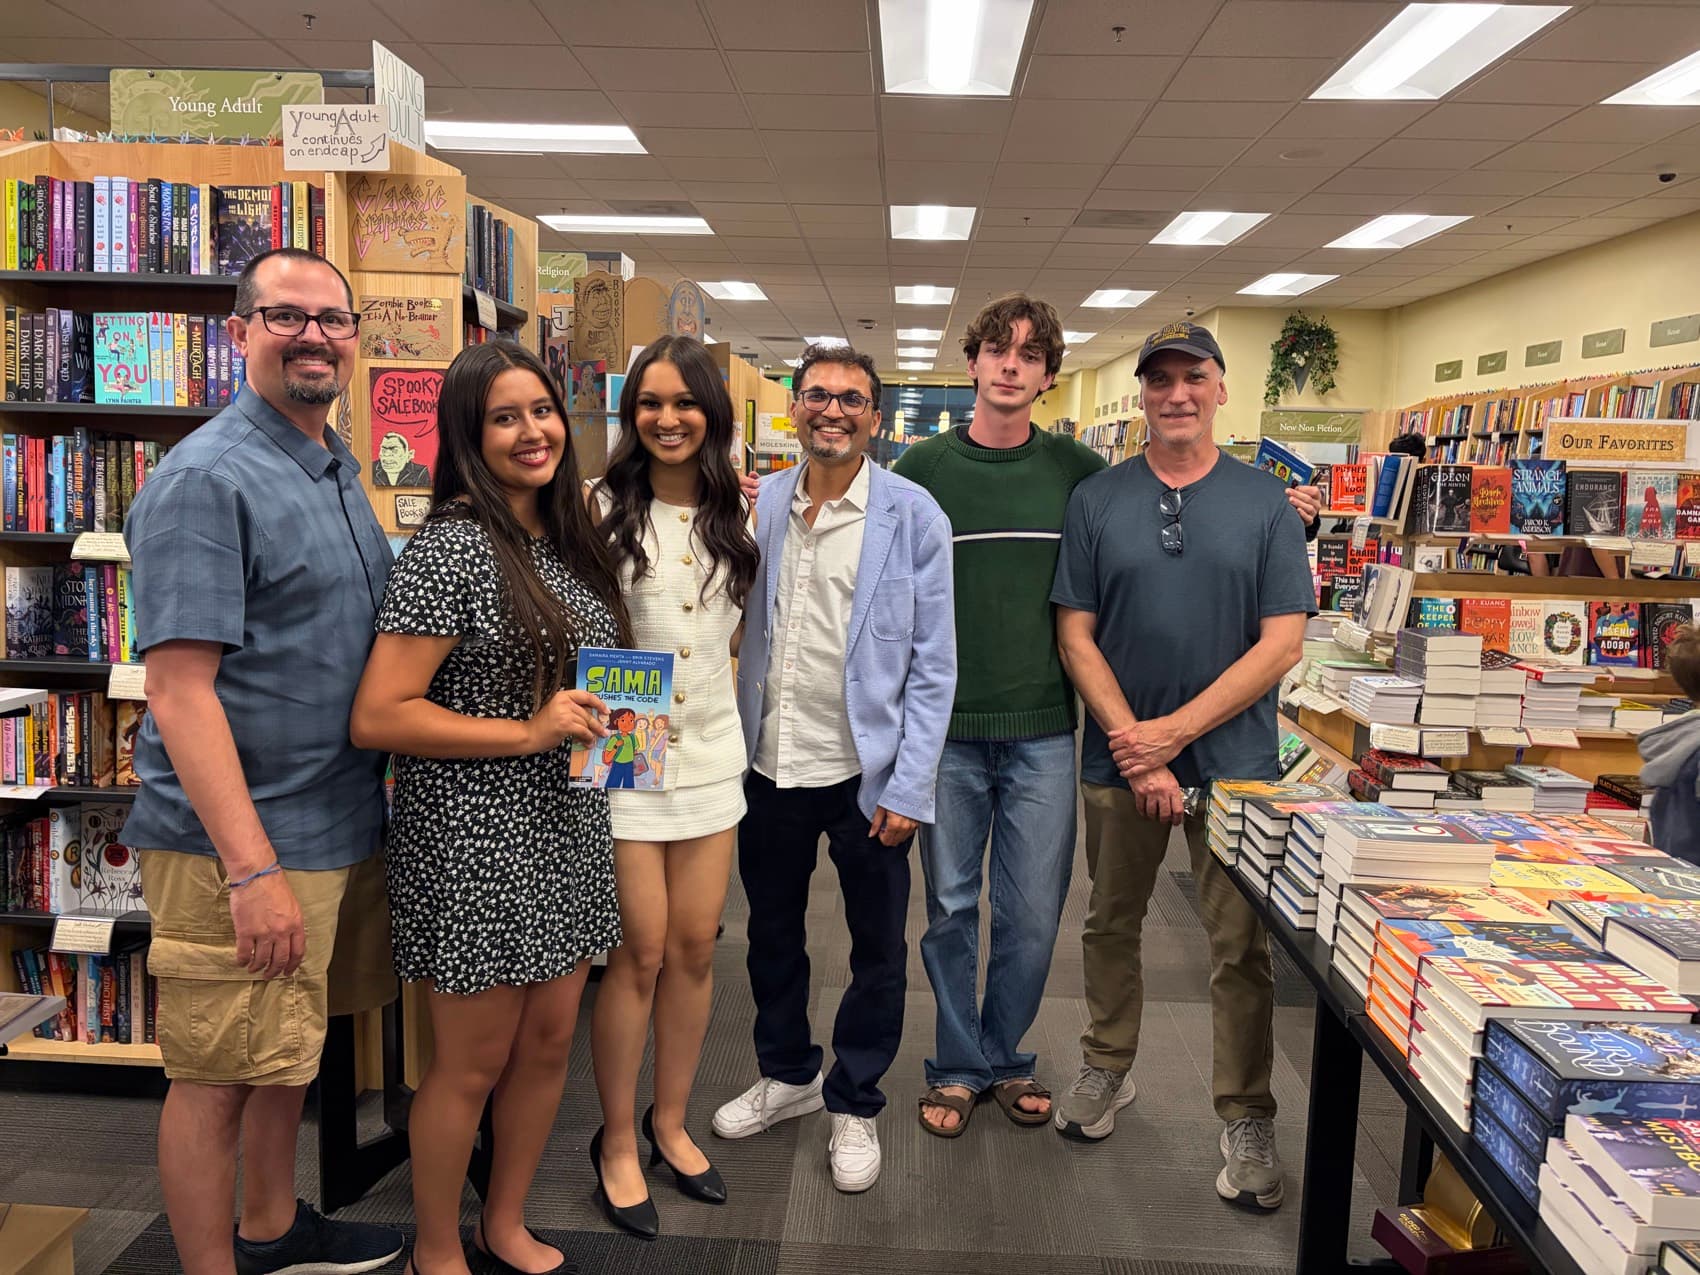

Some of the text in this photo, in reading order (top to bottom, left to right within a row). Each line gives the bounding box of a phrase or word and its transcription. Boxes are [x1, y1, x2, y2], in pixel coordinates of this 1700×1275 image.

[377, 51, 422, 111] YOUNG
[169, 96, 262, 116] Young Adult
[303, 135, 362, 144] continues
[290, 145, 359, 164] on endcap
[149, 184, 158, 203] Soul
[223, 190, 236, 200] THE
[162, 187, 172, 232] MOONSICK
[237, 203, 269, 216] LIGHT
[36, 190, 45, 249] SHADOW REAPER
[149, 215, 158, 244] Shadow
[537, 266, 569, 278] Religion
[362, 298, 403, 312] Zombie
[96, 316, 144, 326] BETTING
[113, 332, 129, 340] ON
[20, 330, 30, 389] DARK HEIR
[34, 329, 43, 388] DARK HEIR
[191, 332, 202, 379] MURTAGH
[97, 363, 147, 384] YOU
[383, 377, 443, 397] SPOOKY
[1280, 424, 1342, 432] New Non Fiction
[95, 461, 103, 492] TREACHERY
[1431, 472, 1470, 482] GIDEON
[1514, 468, 1561, 481] STRANGE
[1515, 481, 1560, 493] ANIMALS
[398, 498, 418, 508] SALE
[1464, 617, 1507, 629] POPPY
[1596, 626, 1634, 637] ARSENIC
[1601, 641, 1630, 649] ADOBO
[586, 665, 662, 696] SAMA
[103, 999, 111, 1021] HEIST
[1513, 1018, 1625, 1077] BOUND
